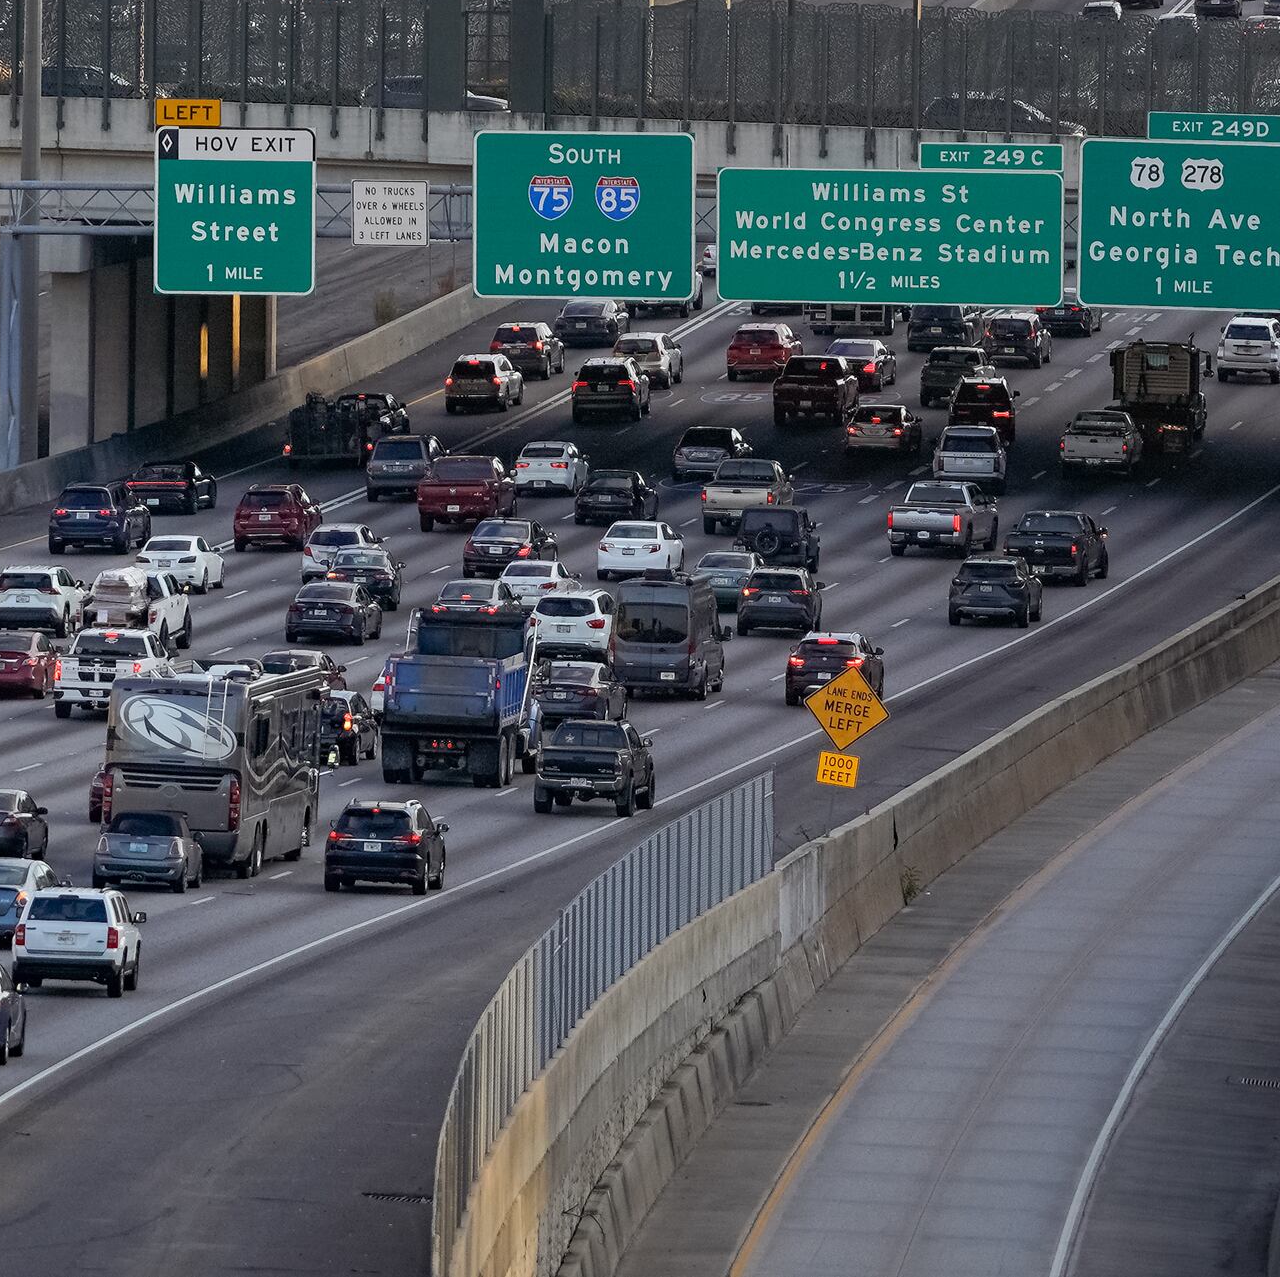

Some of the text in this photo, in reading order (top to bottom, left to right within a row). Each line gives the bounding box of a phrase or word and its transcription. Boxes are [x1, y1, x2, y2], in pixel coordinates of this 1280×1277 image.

[163, 105, 214, 121] LEFT
[1172, 120, 1269, 137] EXIT 249D
[195, 136, 296, 153] HOV EXIT
[940, 151, 970, 162] EXIT
[1134, 163, 1160, 182] 78
[1183, 165, 1222, 184] 278
[174, 183, 296, 205] Williams
[365, 187, 415, 196] NO TRUCKS
[533, 187, 569, 212] 75
[600, 188, 636, 213] 85
[812, 182, 969, 204] Williams St
[356, 201, 424, 211] OVER 6 WHEELS
[364, 216, 417, 225] ALLOWED IN
[736, 211, 1045, 237] World Congress Center
[1110, 205, 1261, 230] North Ave
[191, 221, 279, 242] Street
[359, 231, 422, 241] 3 LEFT LANES
[540, 232, 629, 254] Macon
[730, 240, 1050, 264] Mercedes-Benz Stadium
[1089, 240, 1280, 270] Georgia Tech
[206, 263, 263, 282] 1 MILE
[495, 263, 673, 292] Montgomery
[891, 275, 940, 289] MILES
[1155, 277, 1213, 295] 1 MILE
[827, 686, 873, 702] LANE ENDS
[824, 699, 871, 718] MERGE
[829, 717, 863, 733] LEFT
[824, 756, 853, 770] 1000
[822, 769, 851, 784] FEET
